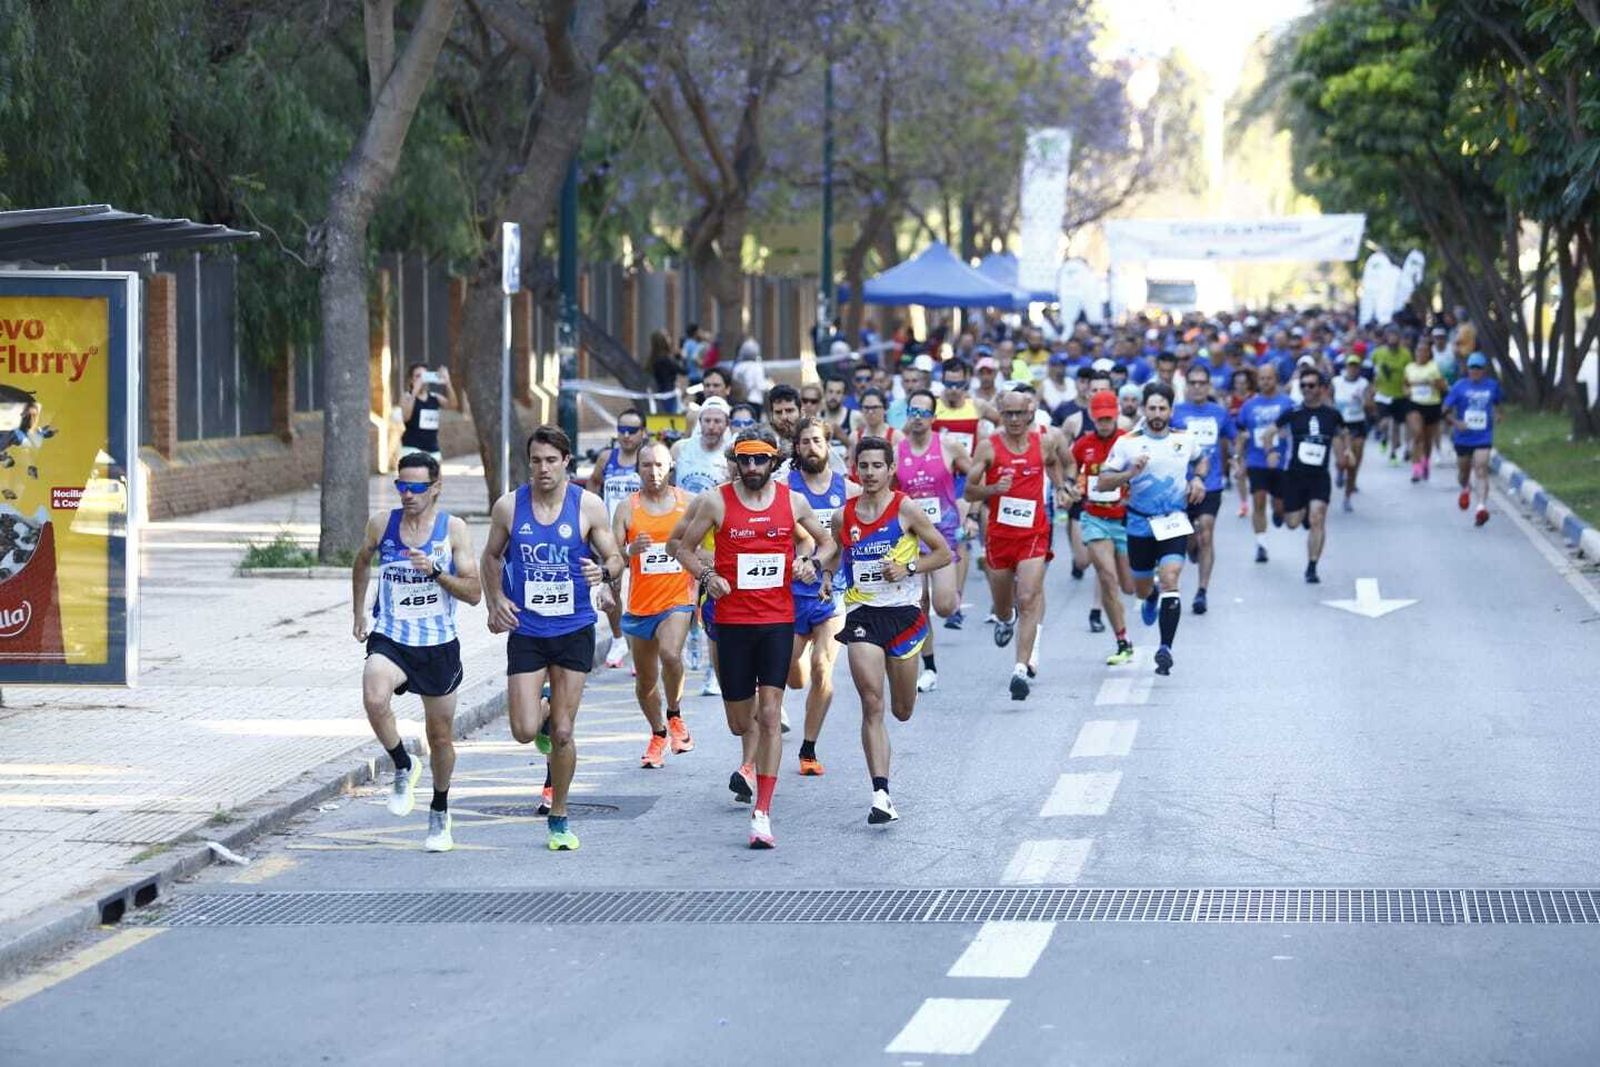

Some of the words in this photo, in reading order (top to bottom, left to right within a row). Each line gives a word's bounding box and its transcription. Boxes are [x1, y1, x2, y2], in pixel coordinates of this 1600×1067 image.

[1002, 507, 1031, 518] 662
[520, 543, 569, 563] RCM
[746, 567, 778, 577] 413
[859, 573, 881, 582] 25
[399, 594, 437, 606] 485
[531, 594, 569, 604] 235
